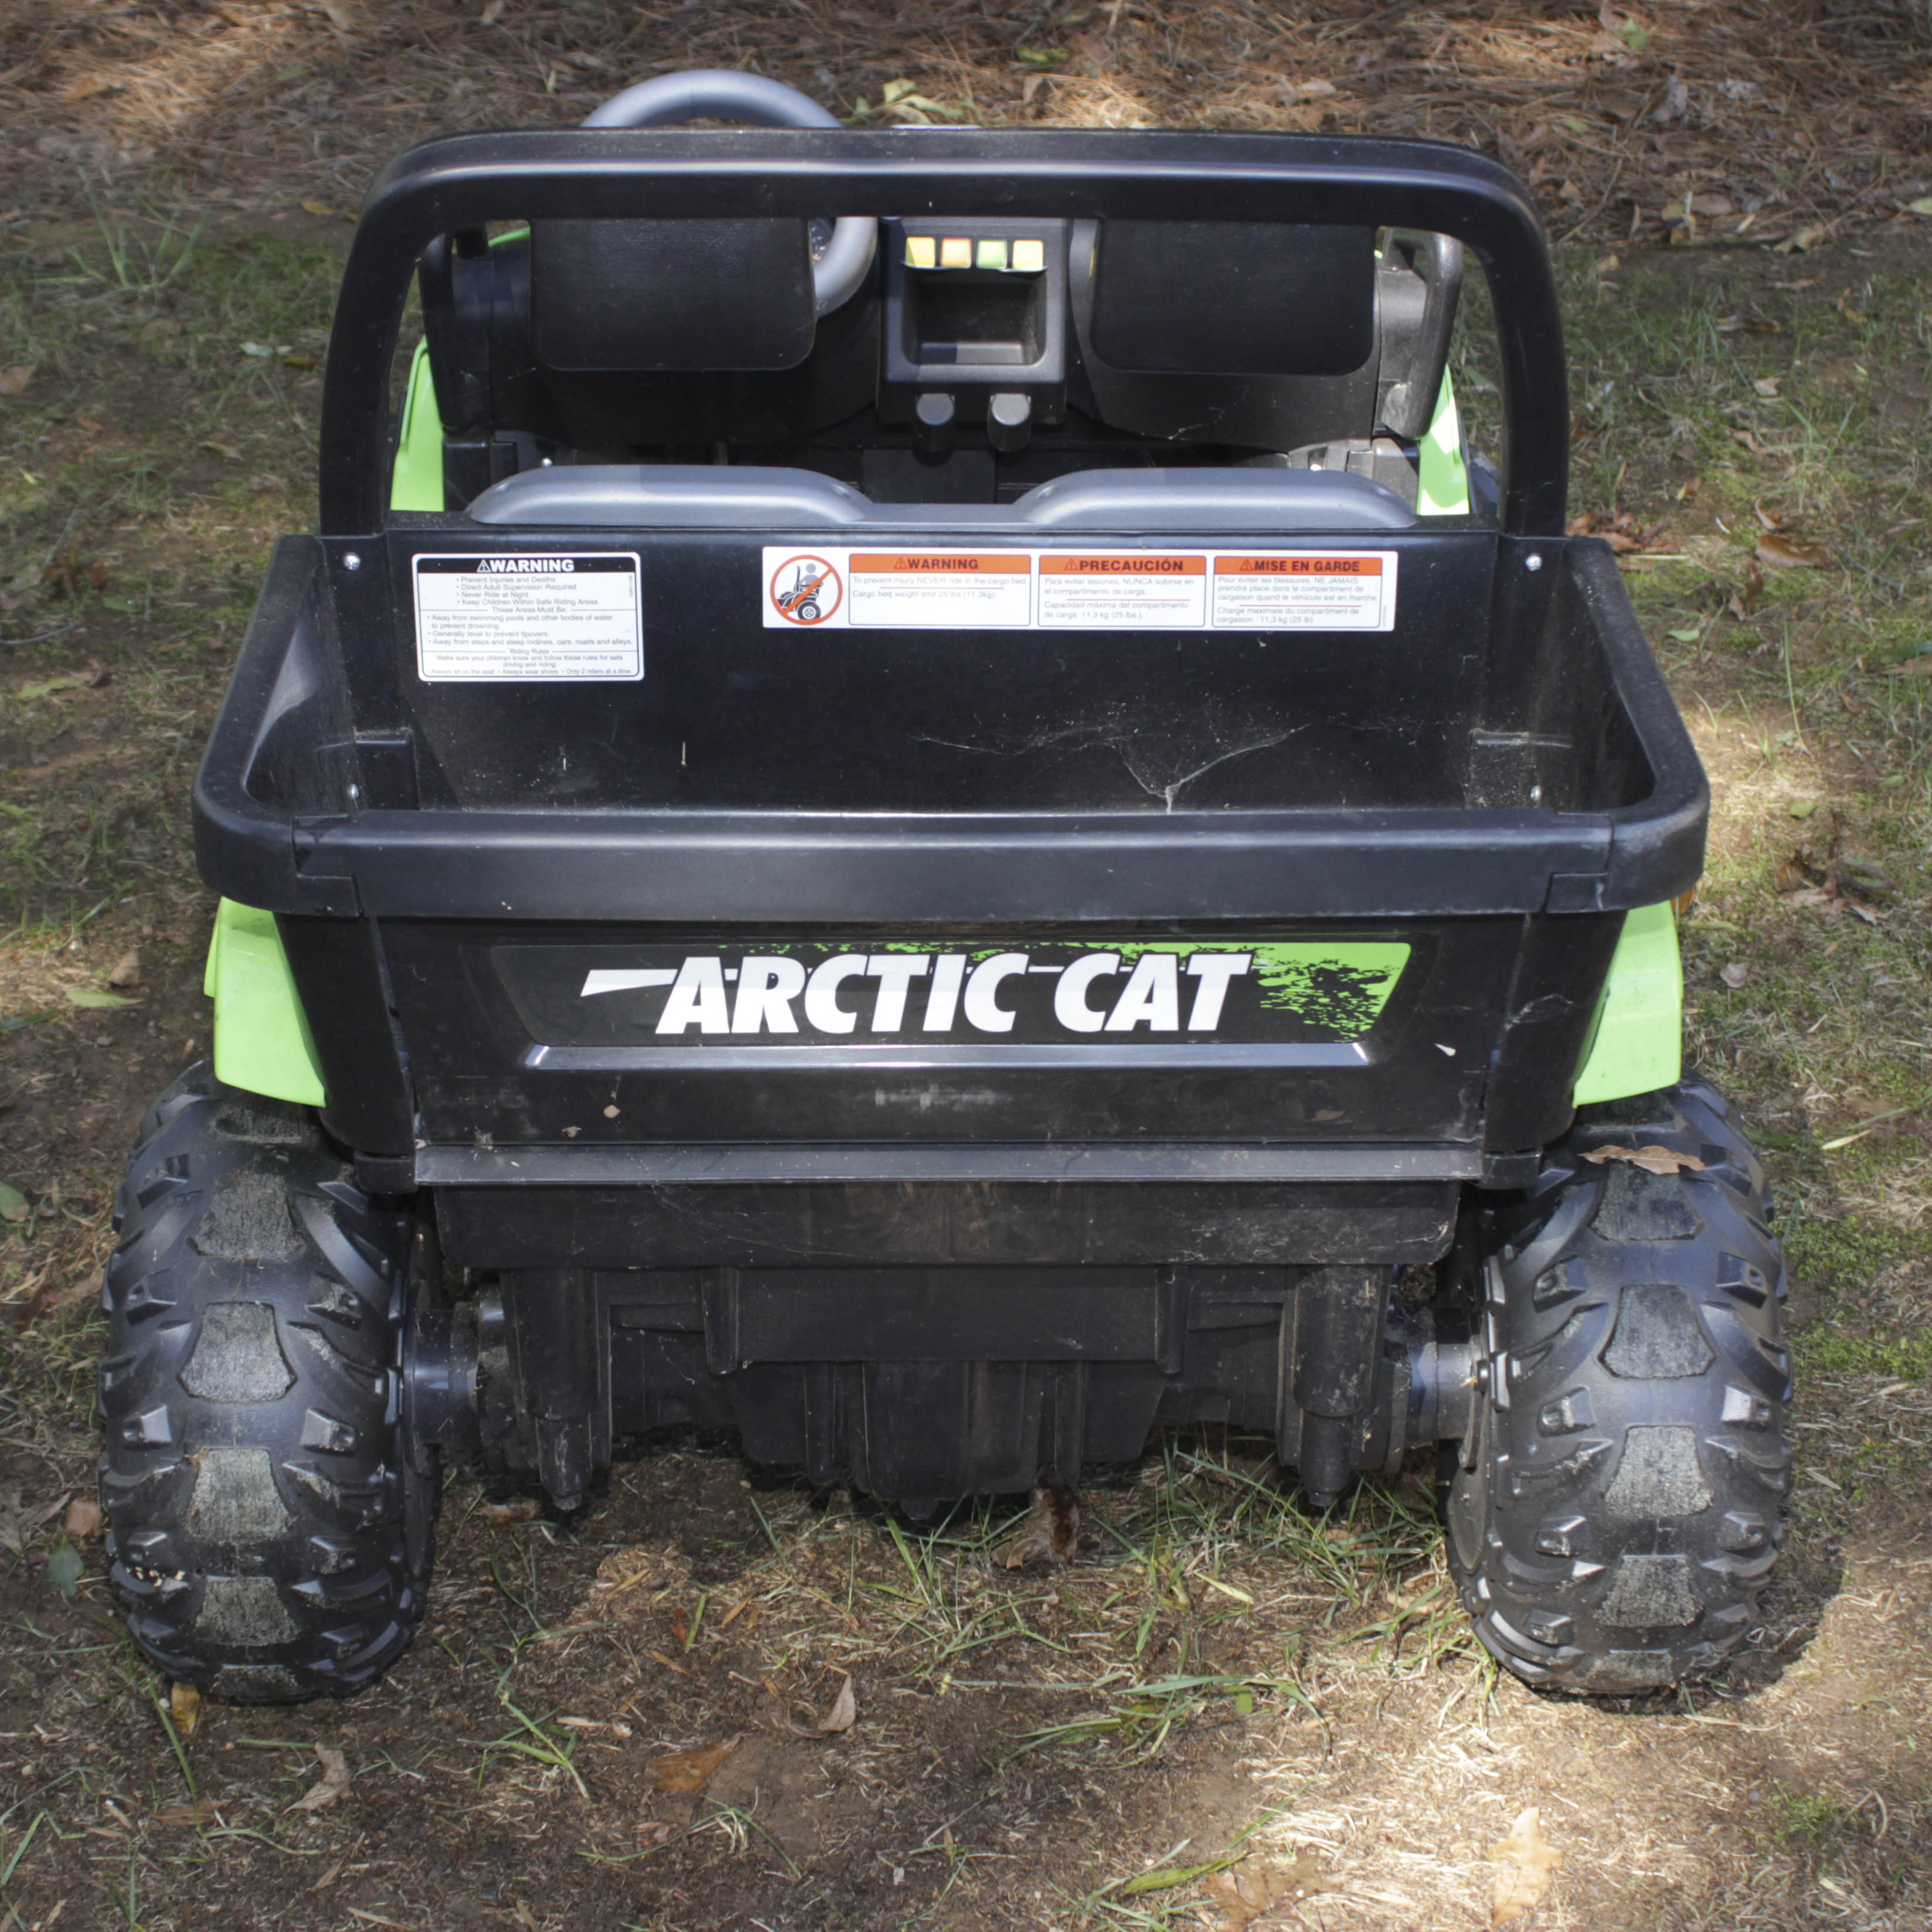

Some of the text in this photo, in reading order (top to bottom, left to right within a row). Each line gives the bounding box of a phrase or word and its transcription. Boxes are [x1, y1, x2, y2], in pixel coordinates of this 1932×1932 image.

[489, 560, 574, 572] WARNING
[908, 559, 978, 570] WARNING
[1079, 559, 1183, 572] PRECAUCIÓN
[1254, 562, 1359, 572] MISE EN GARDE
[853, 590, 875, 598] Cargo
[656, 953, 1254, 1035] ARCTIC CAT
